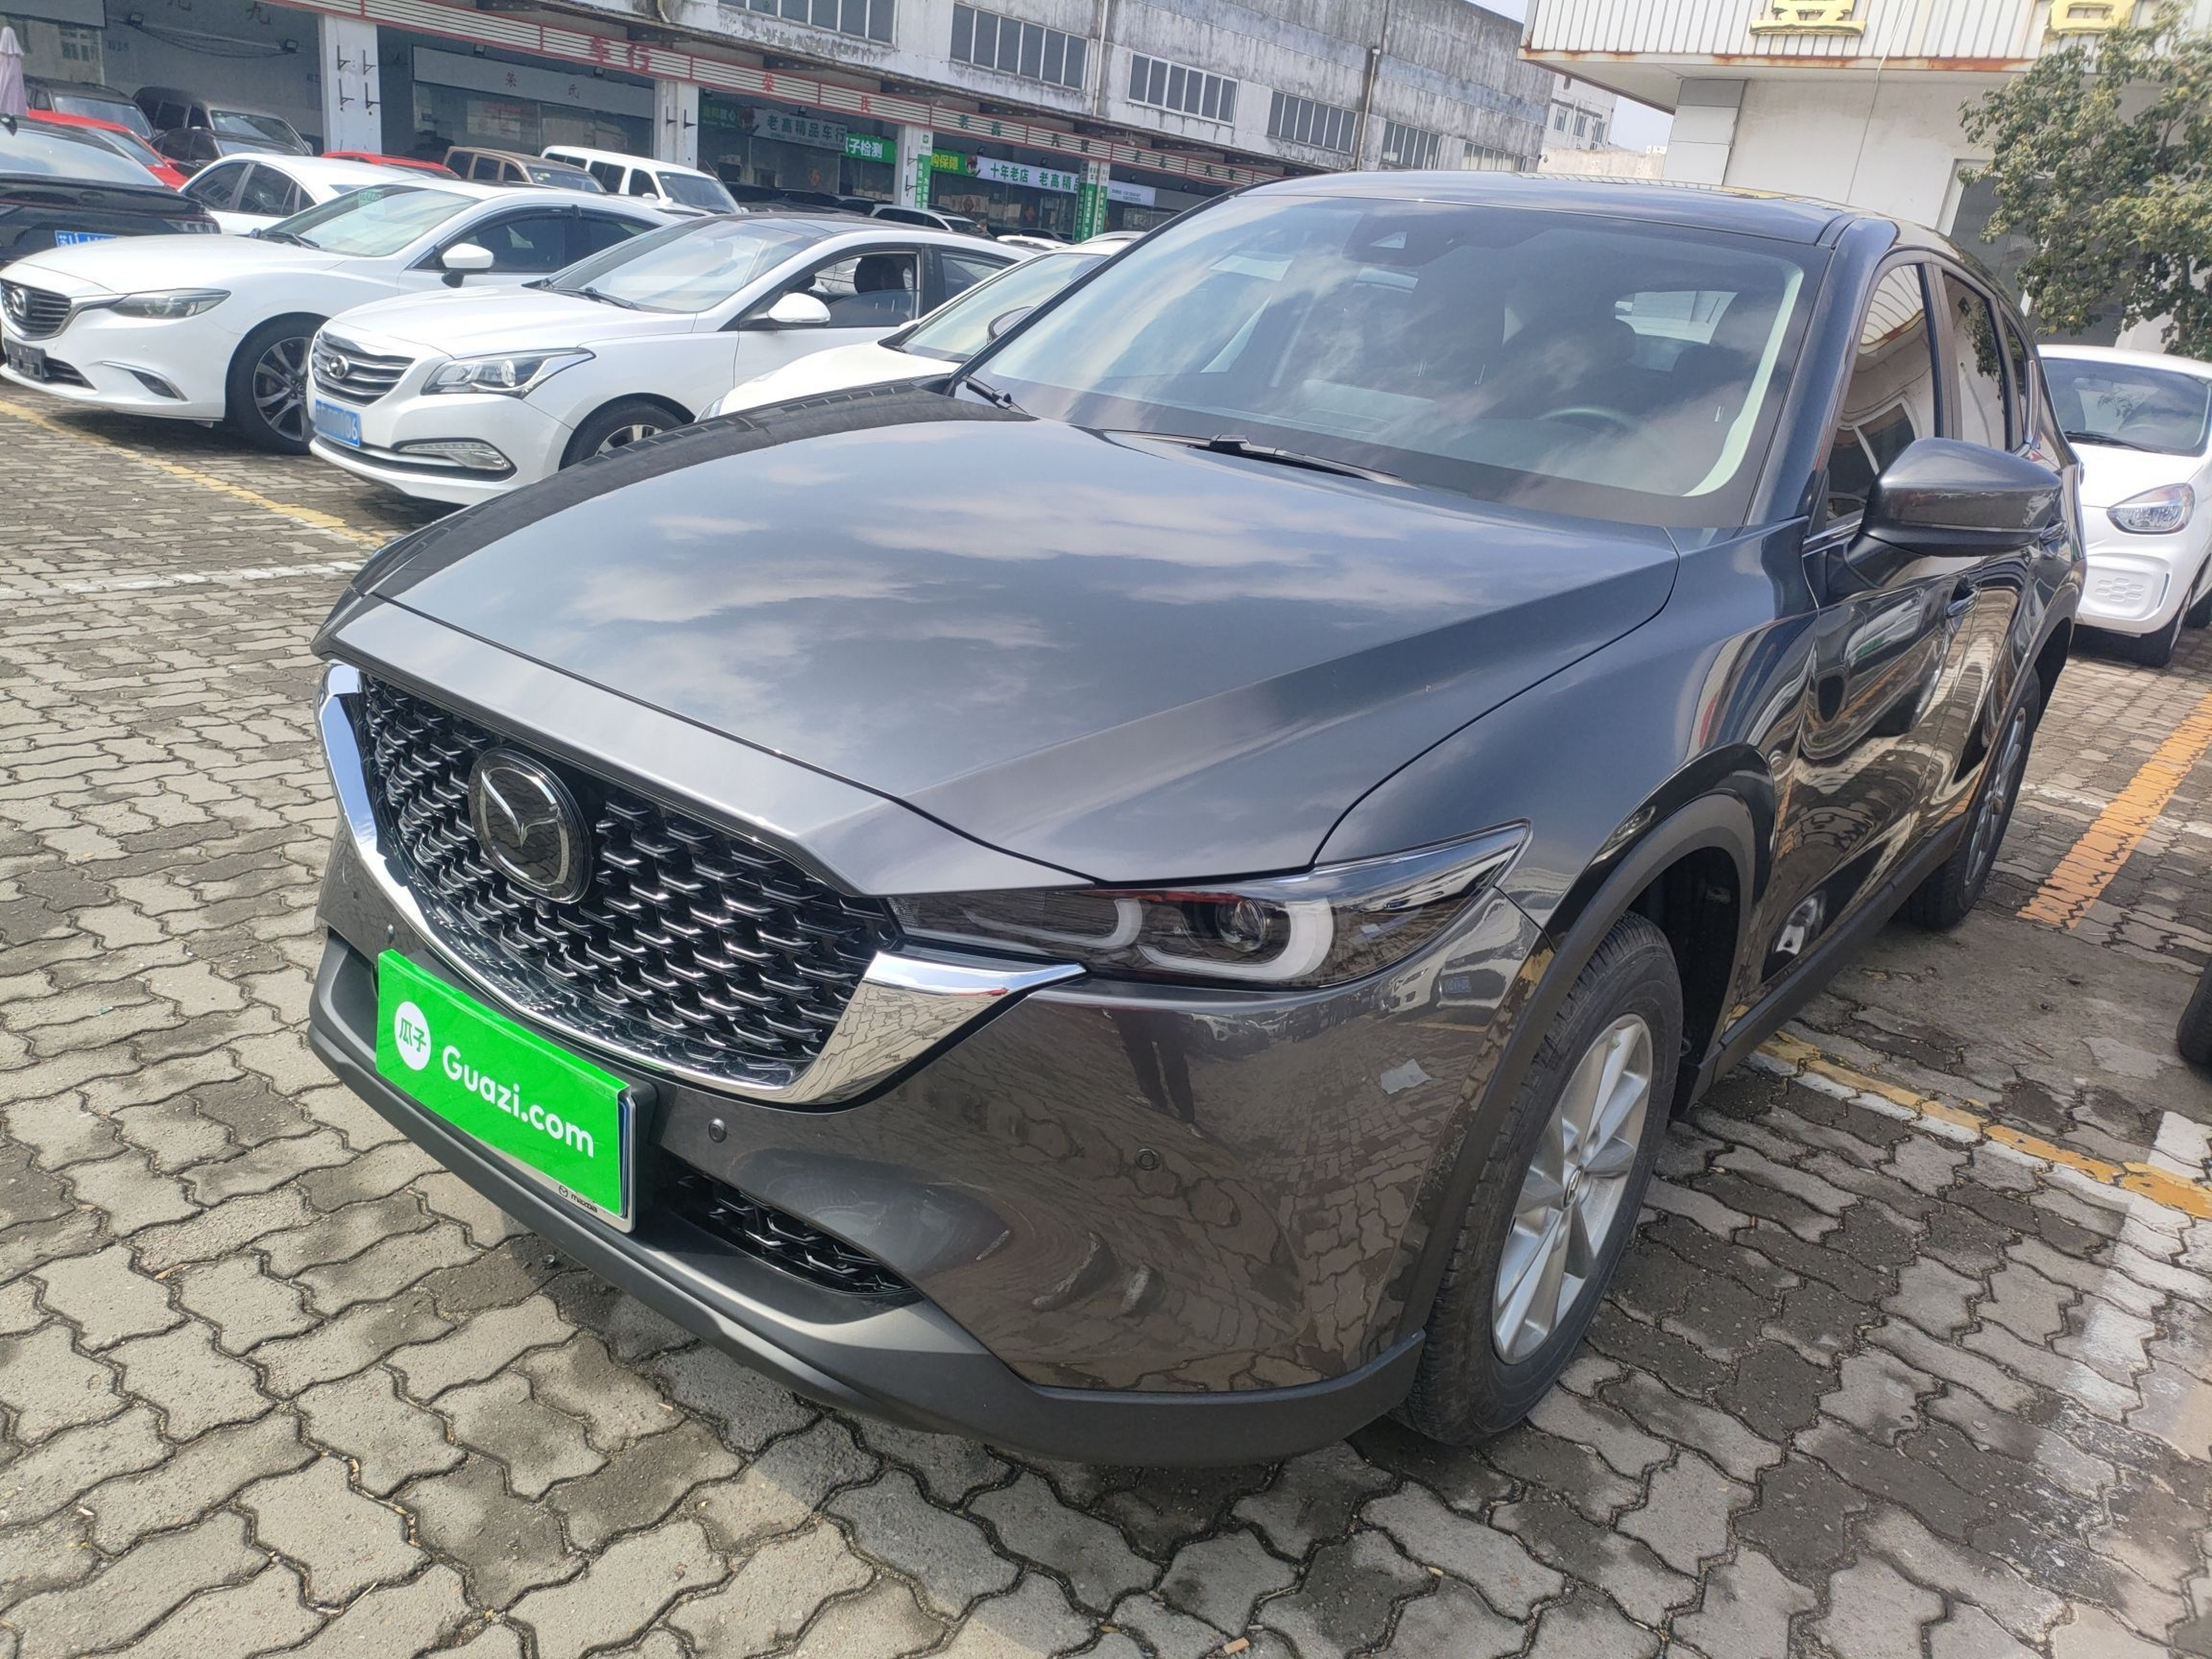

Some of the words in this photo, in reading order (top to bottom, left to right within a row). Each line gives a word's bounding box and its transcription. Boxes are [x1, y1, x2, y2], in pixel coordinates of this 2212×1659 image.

[589, 36, 652, 71] 车行
[767, 115, 846, 143] 老高精品车行
[845, 137, 882, 158] 子检测
[990, 162, 1029, 184] 十年老店
[399, 1015, 427, 1053] 瓜子
[442, 1046, 594, 1158] Guazi.com
[570, 1194, 598, 1213] mazda
